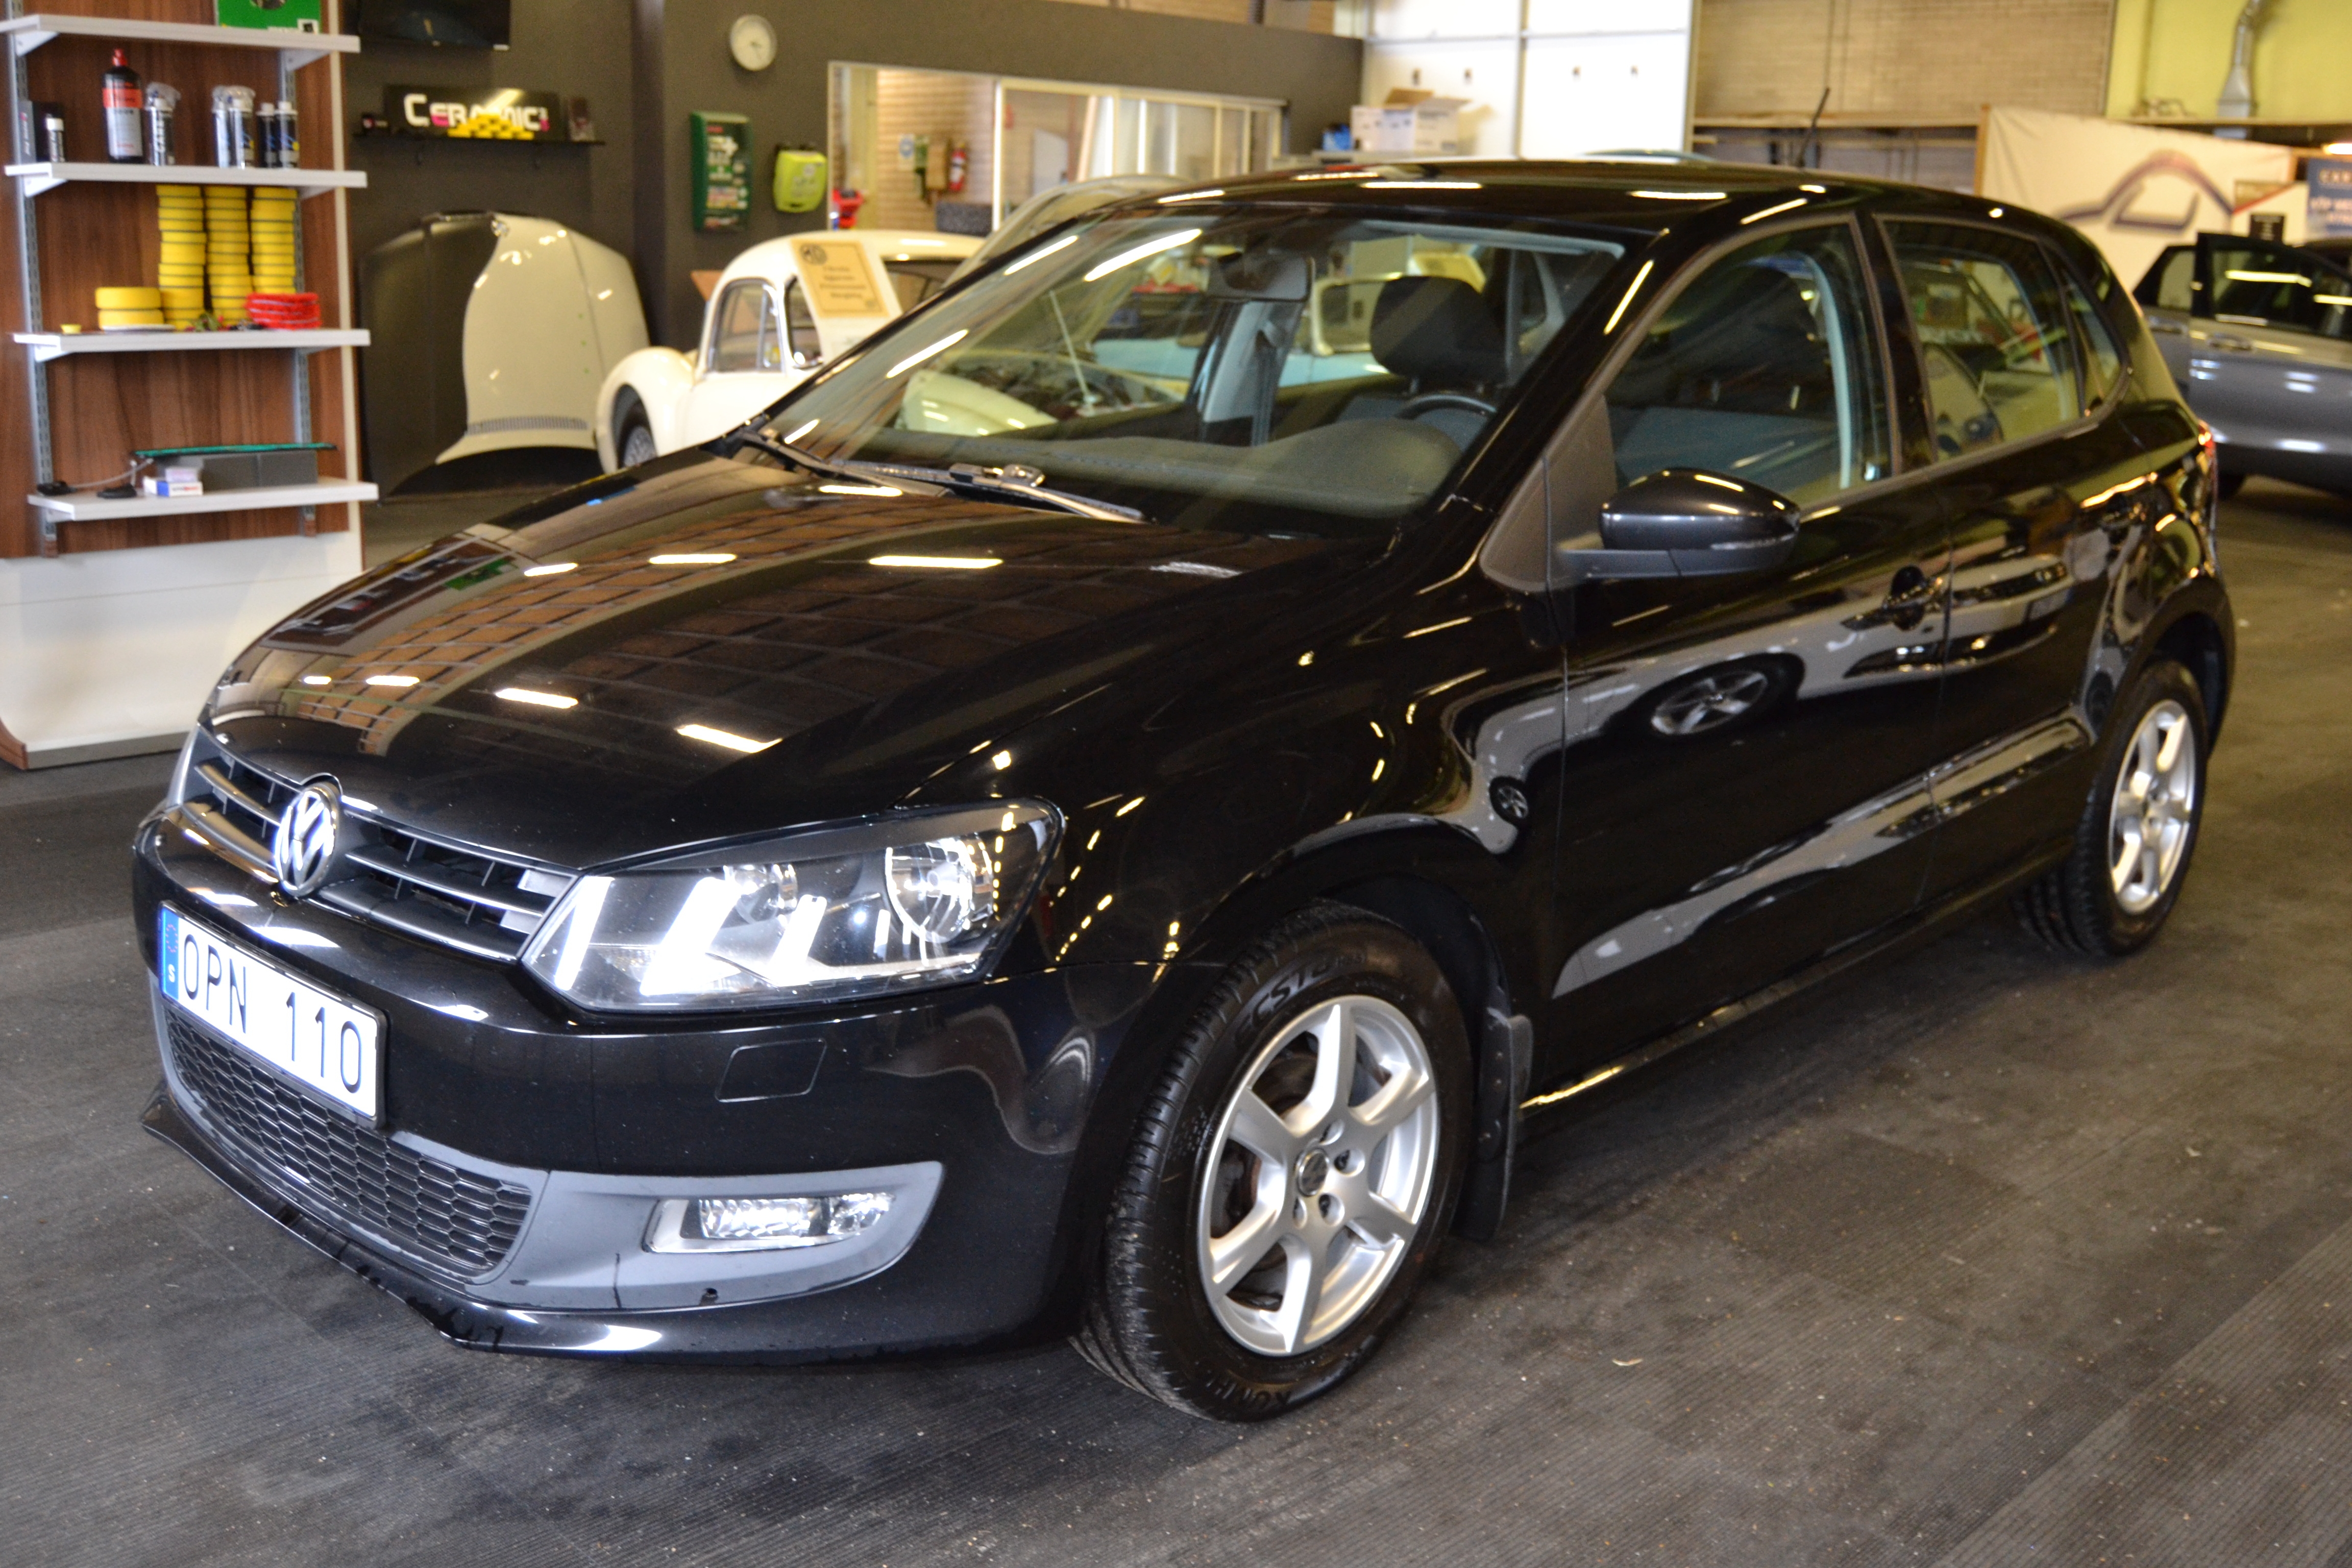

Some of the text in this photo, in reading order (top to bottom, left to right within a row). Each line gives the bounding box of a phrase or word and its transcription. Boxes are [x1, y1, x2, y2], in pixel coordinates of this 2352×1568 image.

[168, 963, 176, 983] S
[183, 934, 362, 1094] OPN 110
